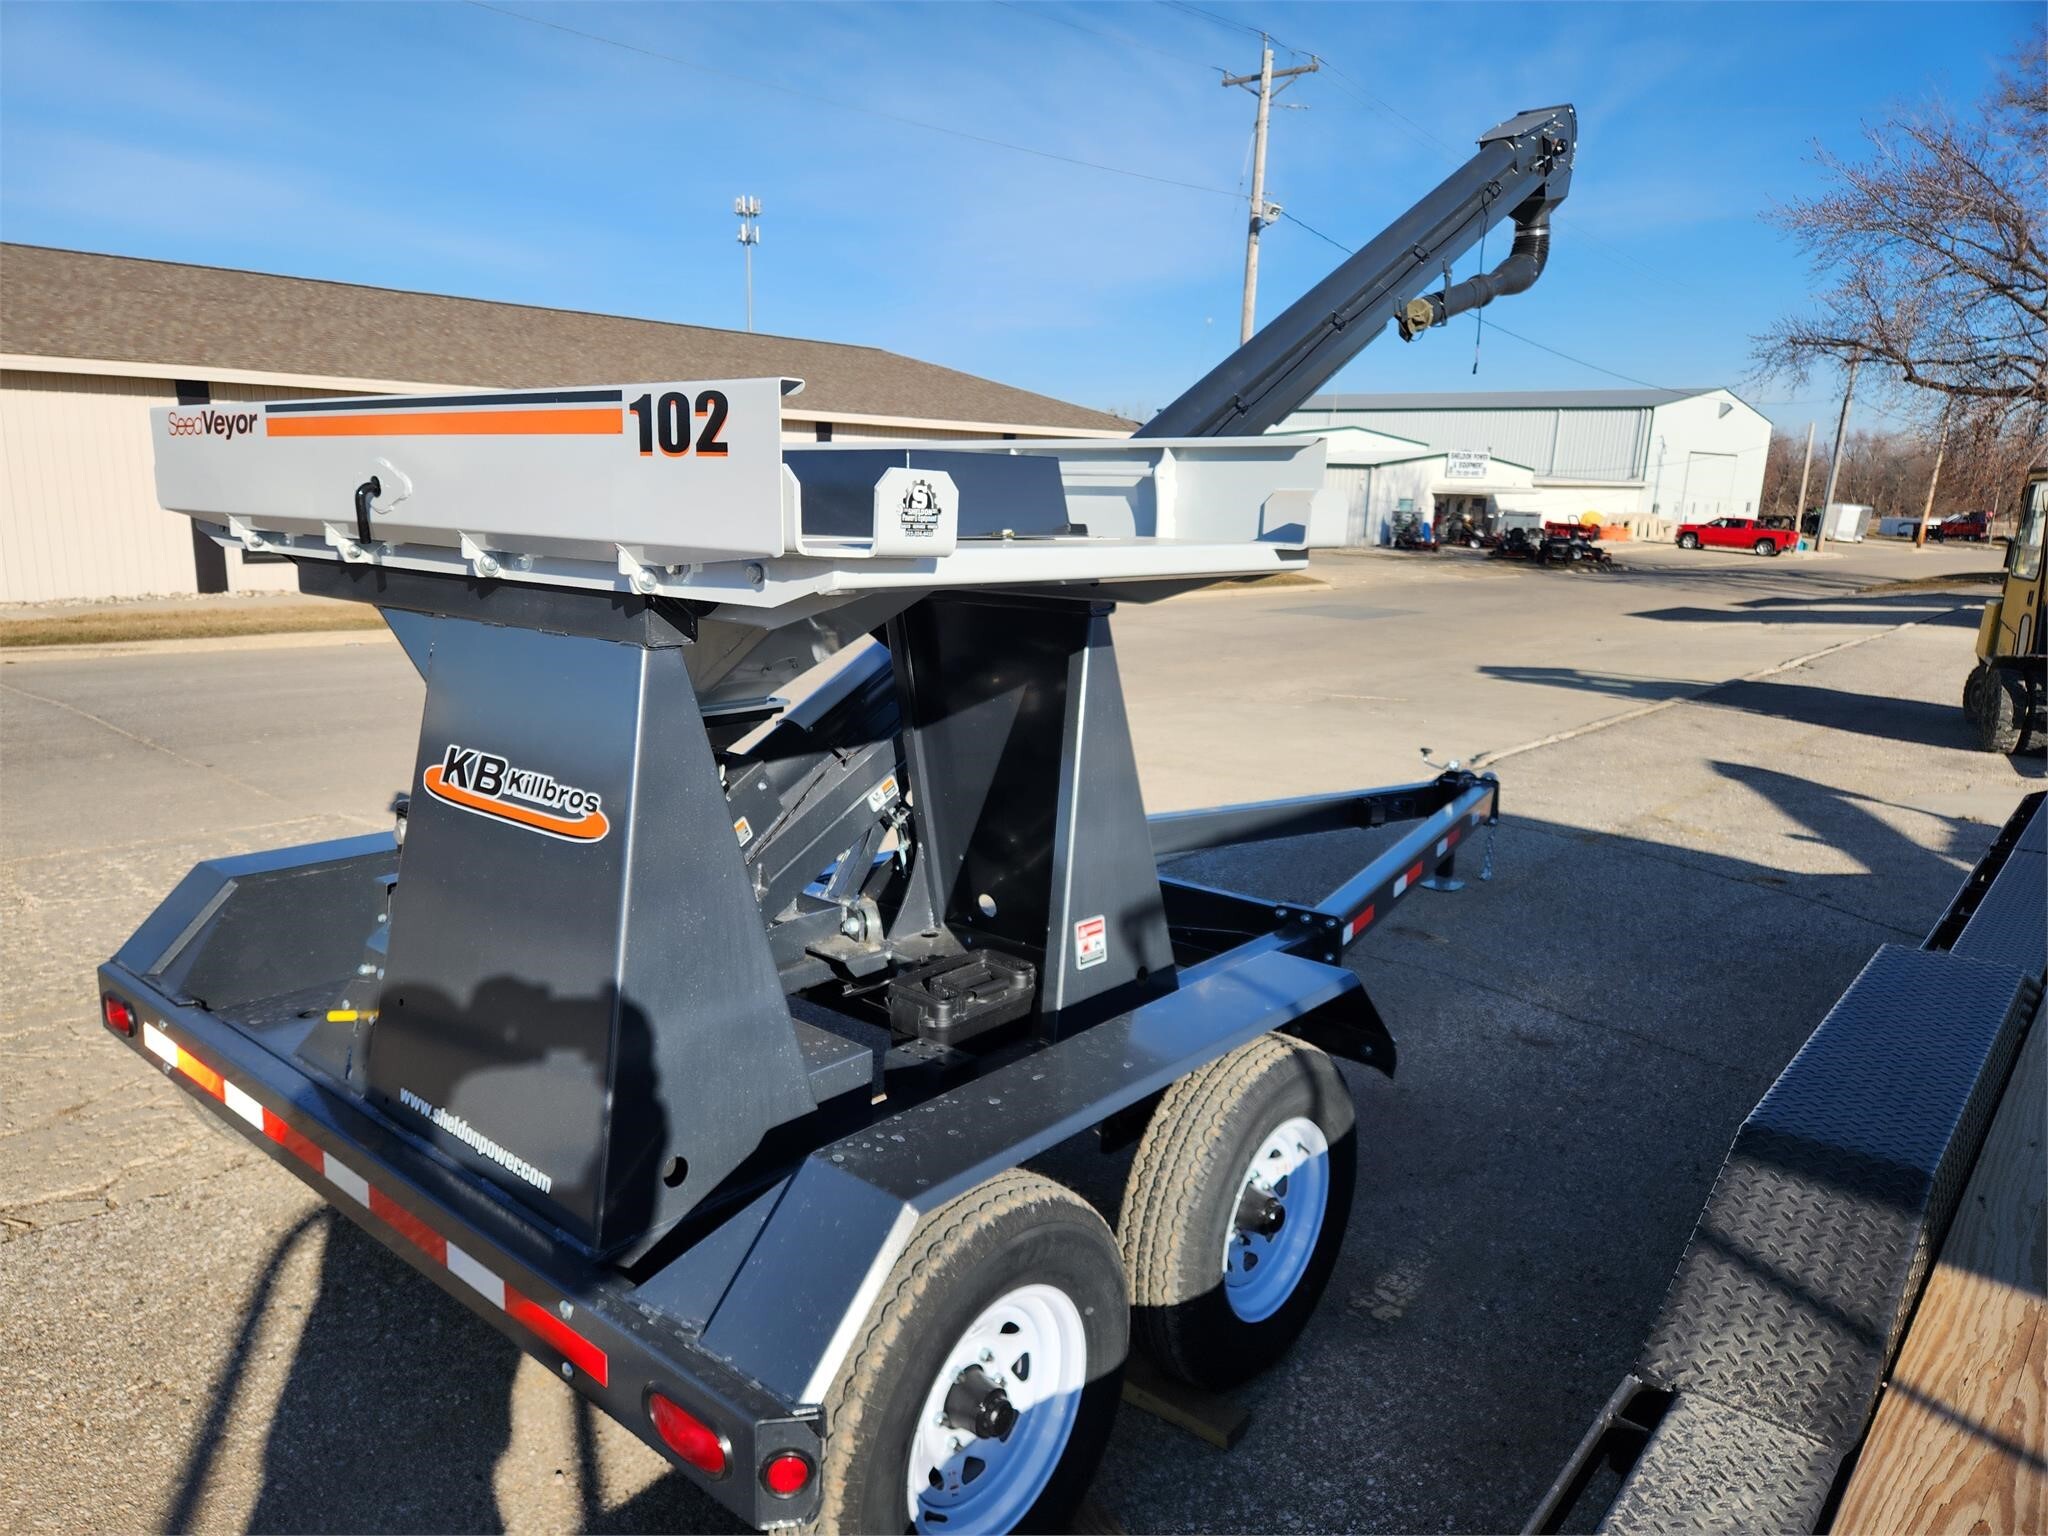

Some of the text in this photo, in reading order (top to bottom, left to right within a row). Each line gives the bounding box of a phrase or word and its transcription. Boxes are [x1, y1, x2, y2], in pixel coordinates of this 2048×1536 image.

[629, 389, 729, 458] 102
[441, 746, 599, 813] KB Killbros
[400, 1087, 552, 1194] www.sheldonpower.com
